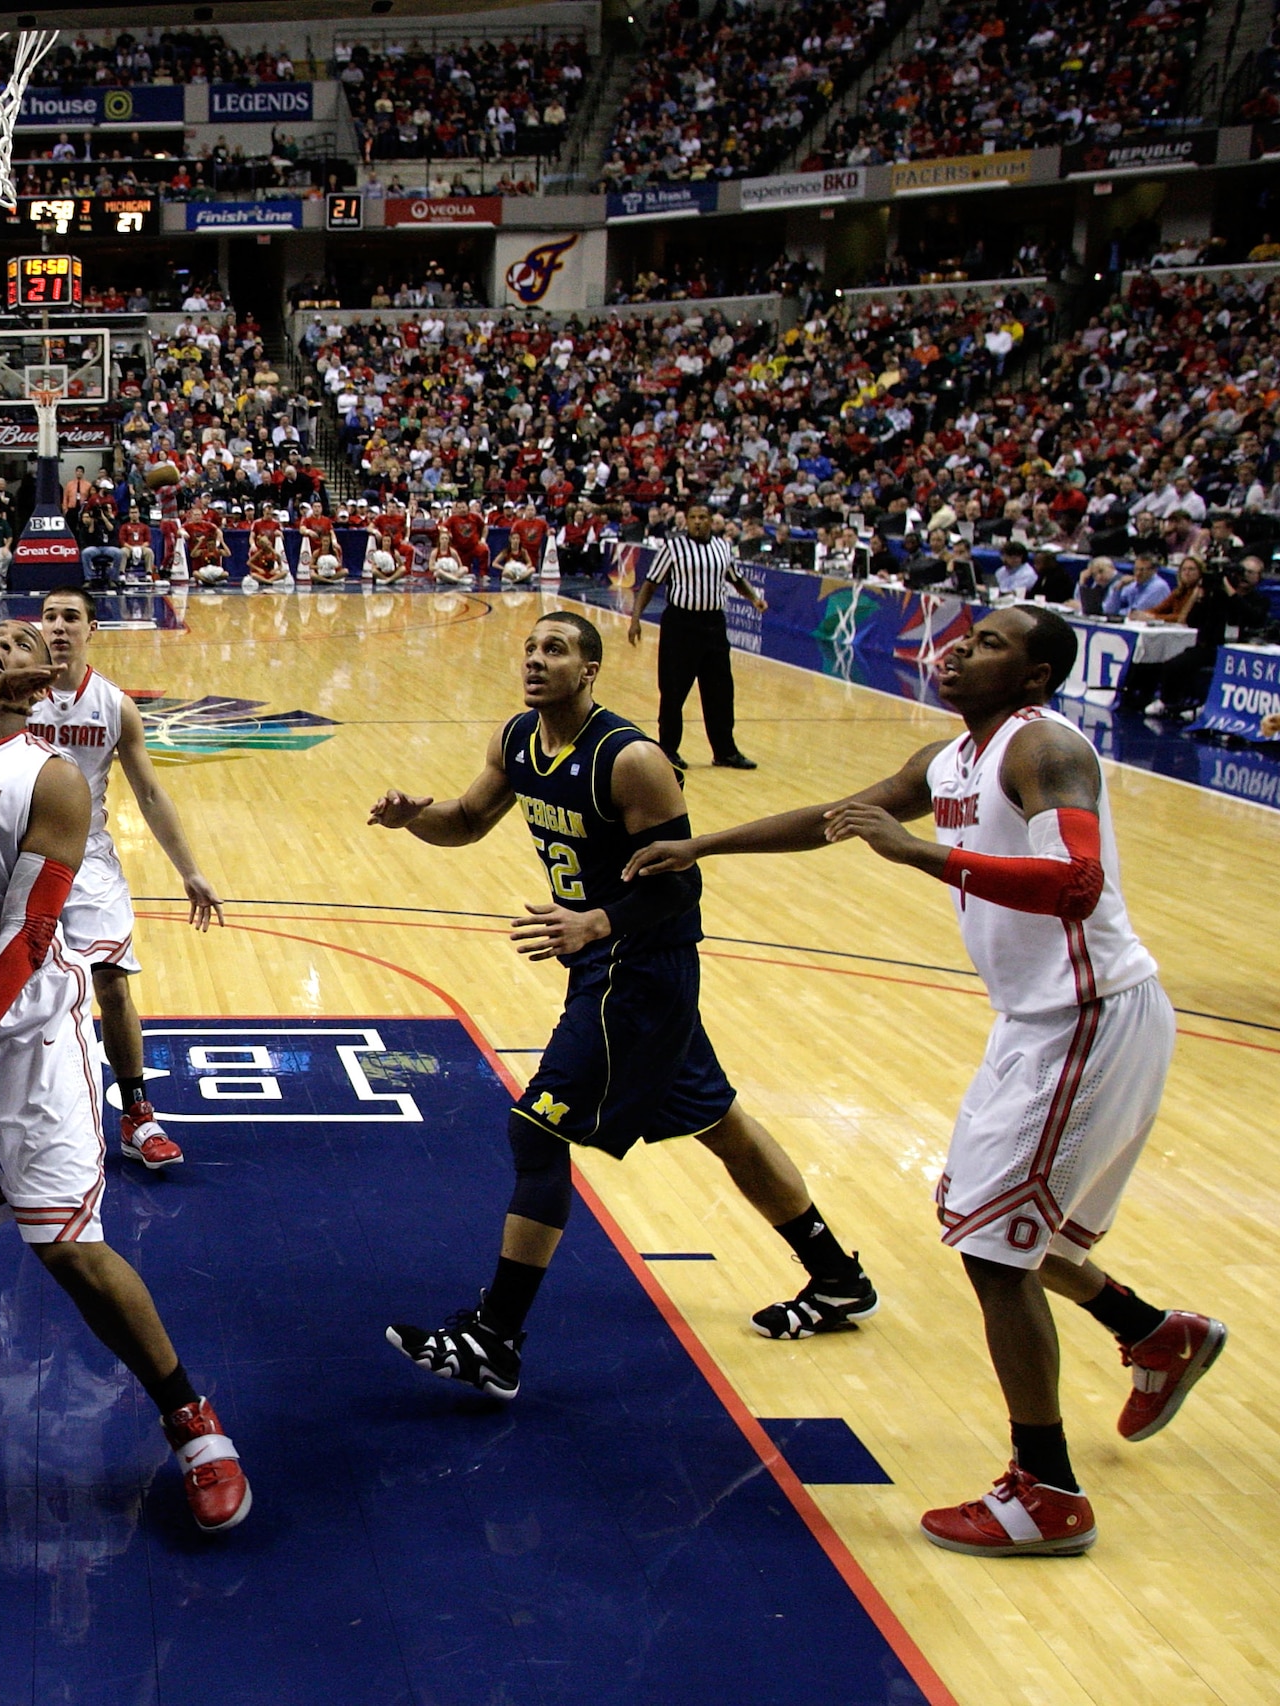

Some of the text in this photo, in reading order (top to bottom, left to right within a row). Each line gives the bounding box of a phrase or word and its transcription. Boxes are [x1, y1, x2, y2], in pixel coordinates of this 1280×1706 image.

[31, 99, 97, 115] house
[213, 91, 309, 113] LEGENDS
[1108, 141, 1194, 162] REPUBLIC
[743, 171, 859, 202] experience BKD
[104, 200, 151, 213] MICHIGAN
[196, 208, 249, 224] Finish
[333, 199, 357, 218] 21
[430, 204, 476, 217] VEOLIA
[116, 212, 144, 233] 27
[25, 258, 69, 276] 15:58
[27, 277, 62, 301] 21
[16, 544, 77, 558] Great Clips
[1223, 654, 1280, 685] BASK
[28, 723, 107, 748] HIO STATE
[530, 1090, 571, 1126] M
